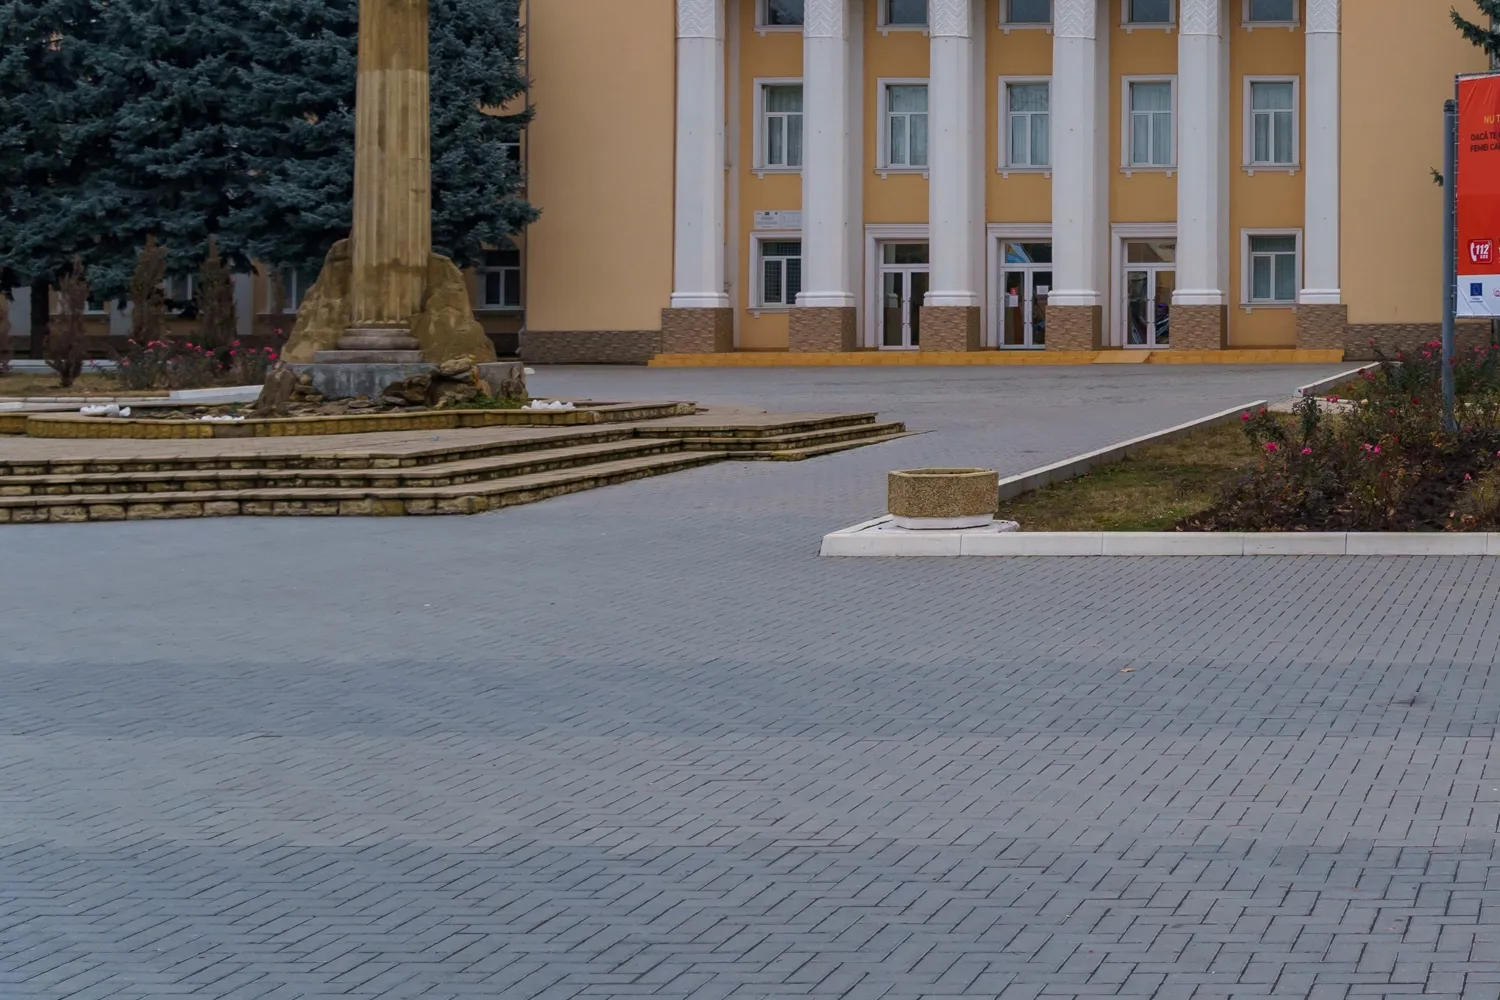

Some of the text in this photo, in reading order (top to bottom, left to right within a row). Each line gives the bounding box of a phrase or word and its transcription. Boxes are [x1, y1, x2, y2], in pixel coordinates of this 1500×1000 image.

[1484, 115, 1495, 124] NU
[1490, 131, 1497, 140] TE
[1470, 143, 1488, 152] FEMEI
[1476, 244, 1489, 254] 112
